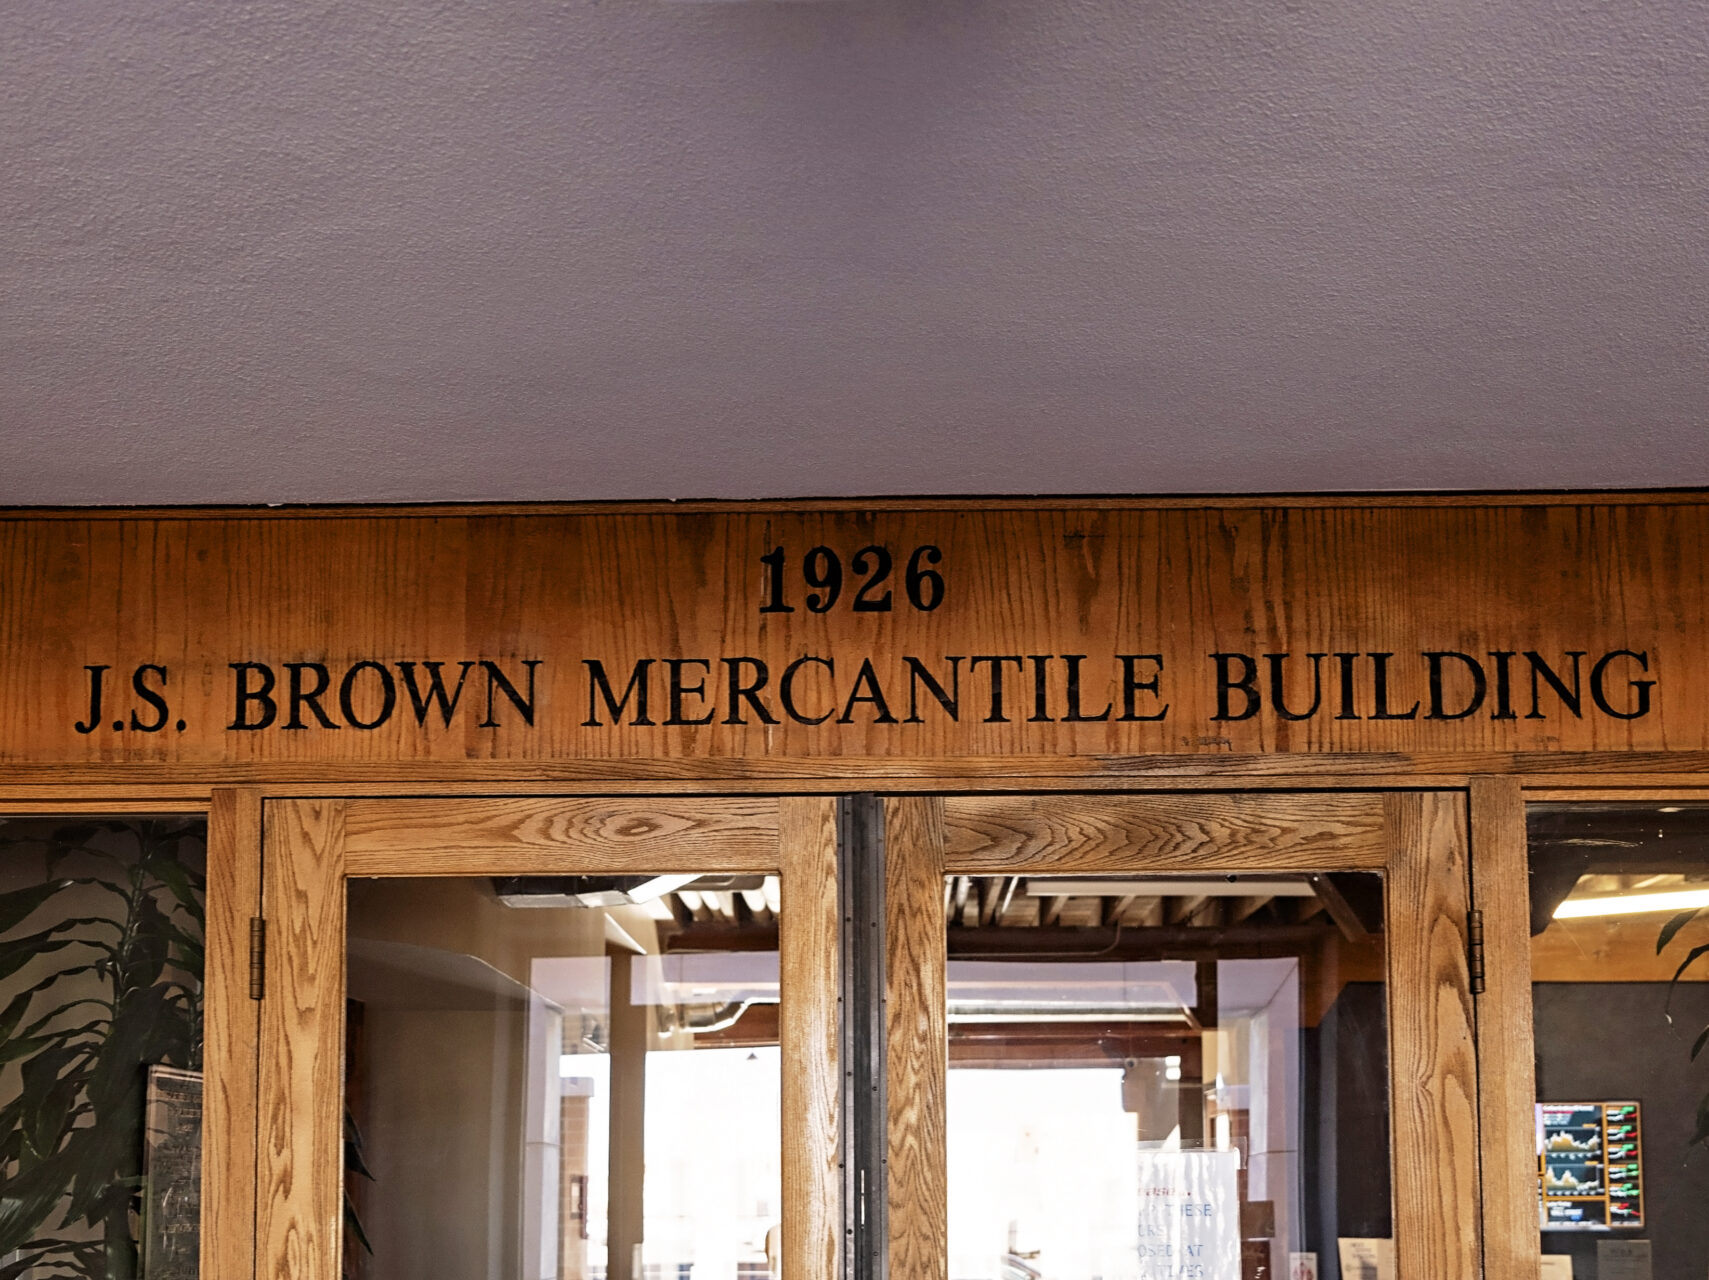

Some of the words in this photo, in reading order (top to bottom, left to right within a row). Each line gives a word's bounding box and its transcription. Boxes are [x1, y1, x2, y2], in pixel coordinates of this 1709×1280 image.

[759, 544, 946, 614] 1926
[74, 663, 187, 735] J.S.
[226, 660, 544, 731] BROWN
[581, 653, 1170, 727] MERCANTILE
[1208, 649, 1657, 721] BUILDING
